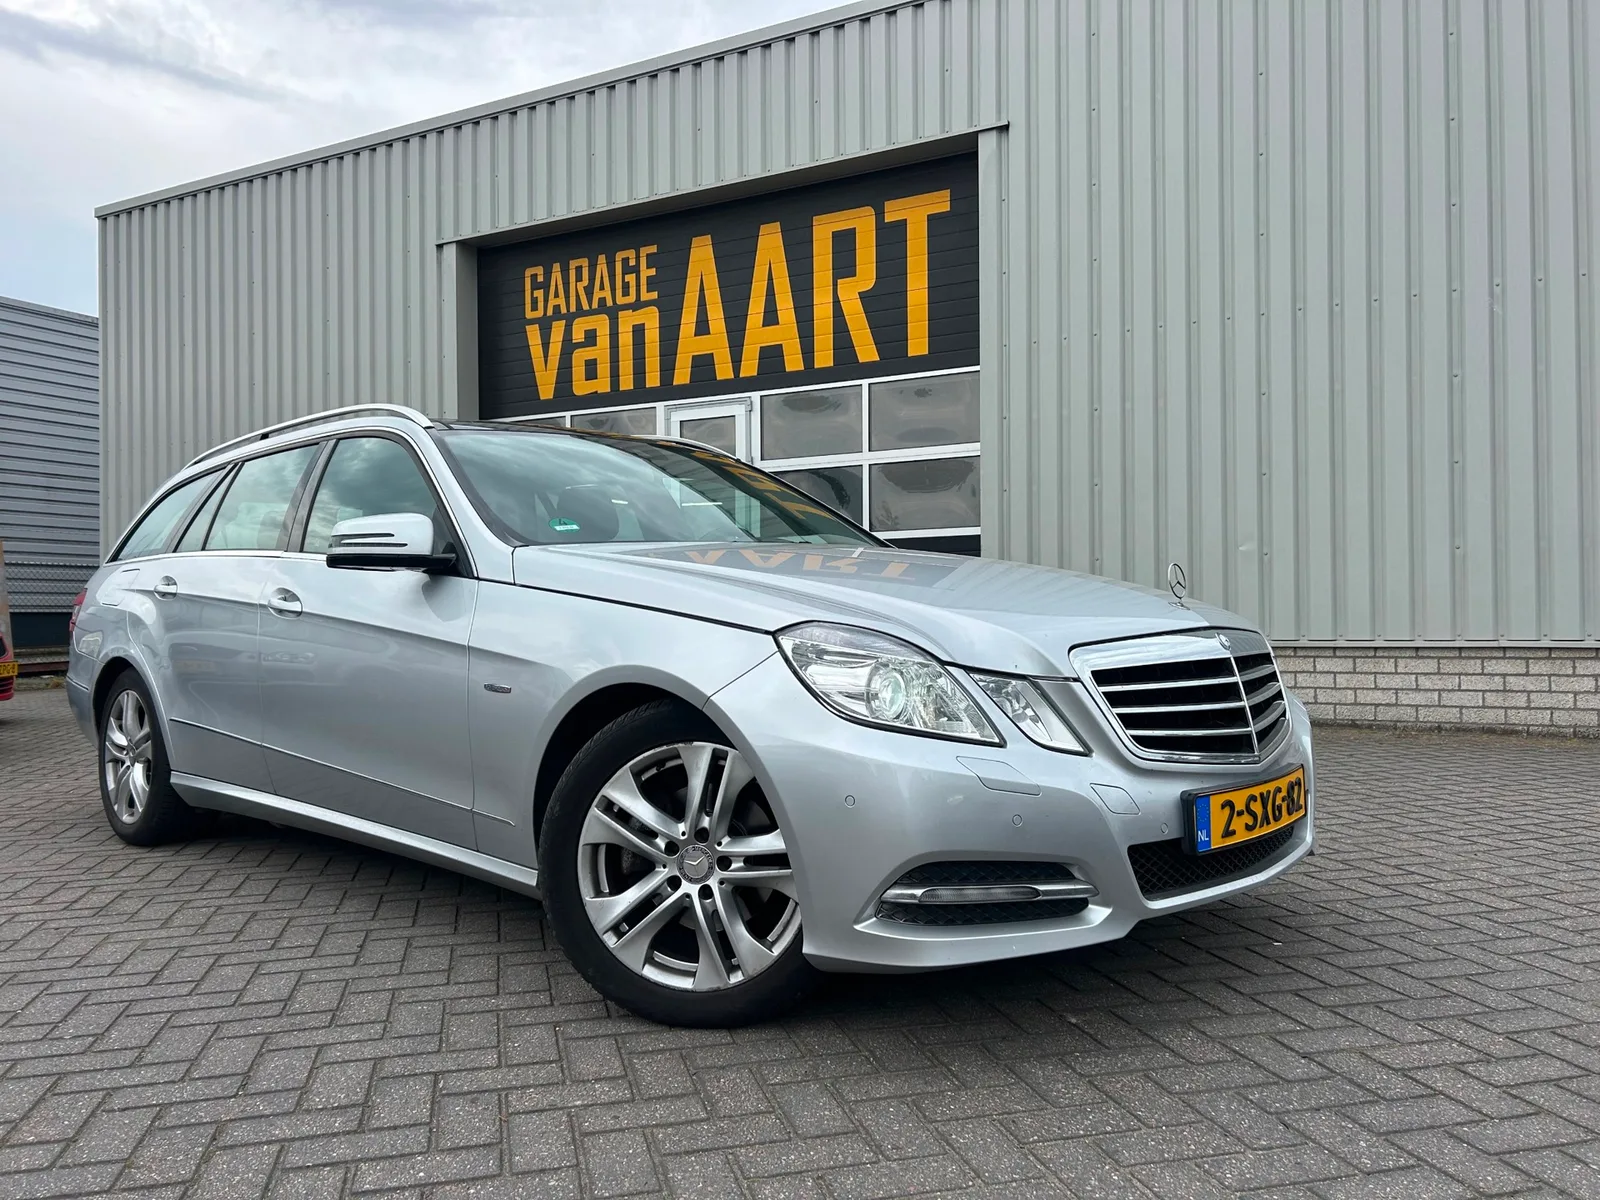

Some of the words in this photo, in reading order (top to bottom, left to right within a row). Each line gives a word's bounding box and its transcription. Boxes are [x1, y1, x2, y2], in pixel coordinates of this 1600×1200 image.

[524, 244, 659, 319] GARAGE
[525, 305, 661, 400] van
[673, 189, 951, 385] AART
[1197, 830, 1210, 842] NL
[1221, 777, 1303, 839] 2-SXG-82
